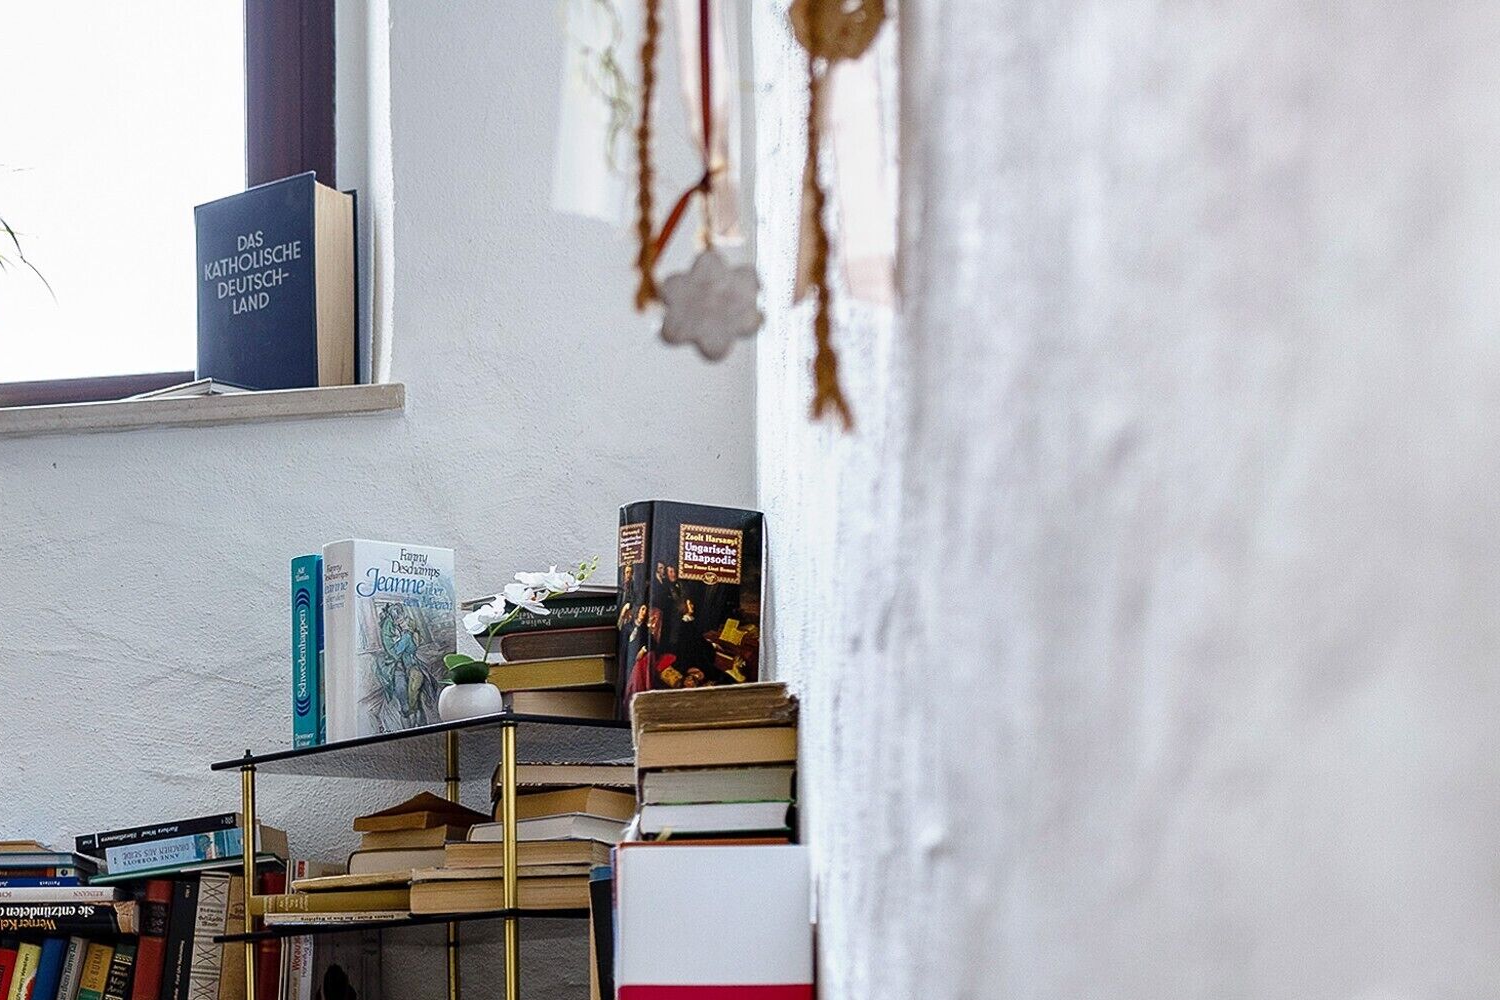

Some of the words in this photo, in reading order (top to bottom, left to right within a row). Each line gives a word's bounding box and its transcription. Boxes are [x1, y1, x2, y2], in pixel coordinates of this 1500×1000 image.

[238, 231, 264, 252] DAS
[204, 241, 301, 280] KATHOLISCHE
[218, 270, 290, 299] DEUTSCH-
[232, 292, 270, 315] LAND
[400, 549, 428, 565] Fanny
[685, 542, 737, 556] Ungarische
[684, 551, 736, 566] Rhapsodie
[391, 561, 440, 579] Deschamps
[356, 567, 425, 597] Jeanne
[297, 609, 306, 696] Schwedenhappen
[6, 906, 75, 919] entzündeten
[78, 905, 94, 918] sie
[17, 919, 56, 929] Werner
